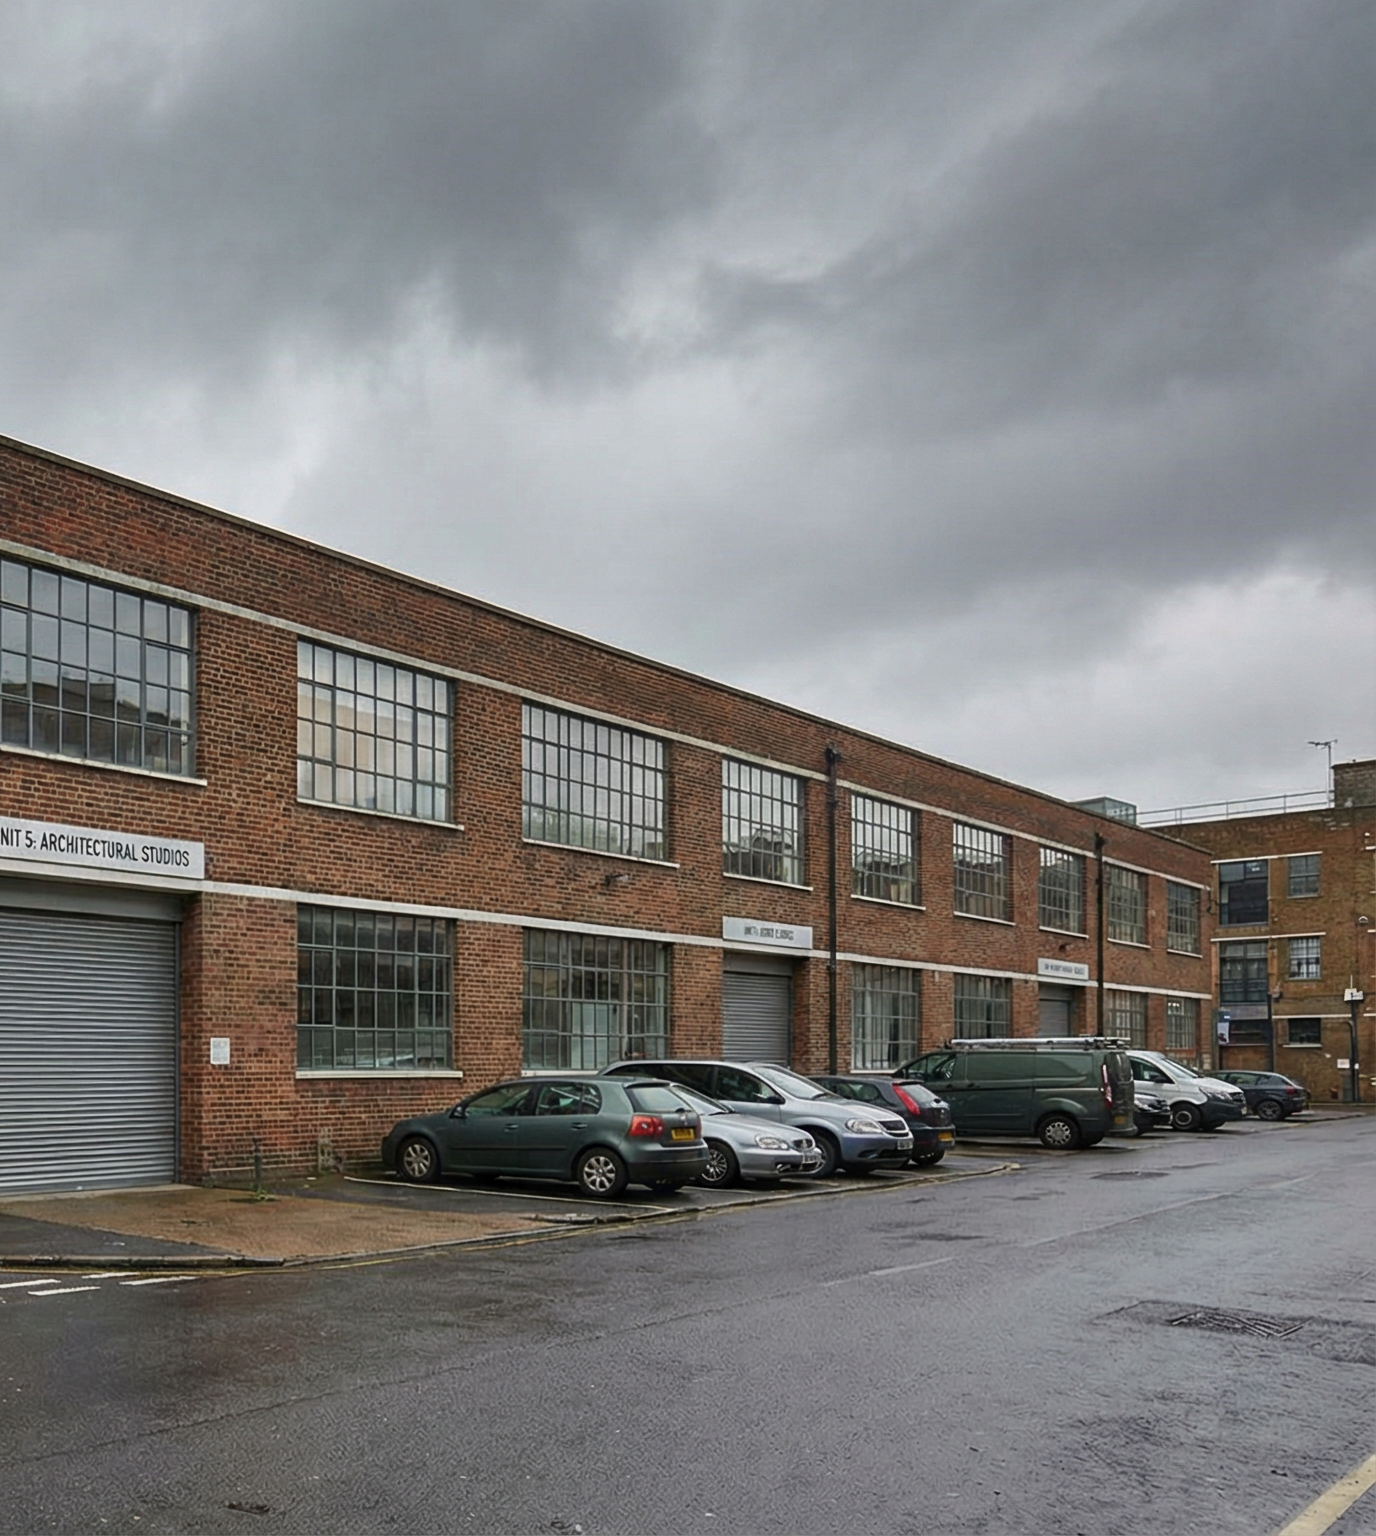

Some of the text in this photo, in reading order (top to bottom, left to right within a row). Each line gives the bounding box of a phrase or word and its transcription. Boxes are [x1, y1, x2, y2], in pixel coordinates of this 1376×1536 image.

[25, 831, 37, 850] 5:
[40, 832, 139, 862] ARCHITECTURAL
[141, 845, 190, 867] STUDIOS
